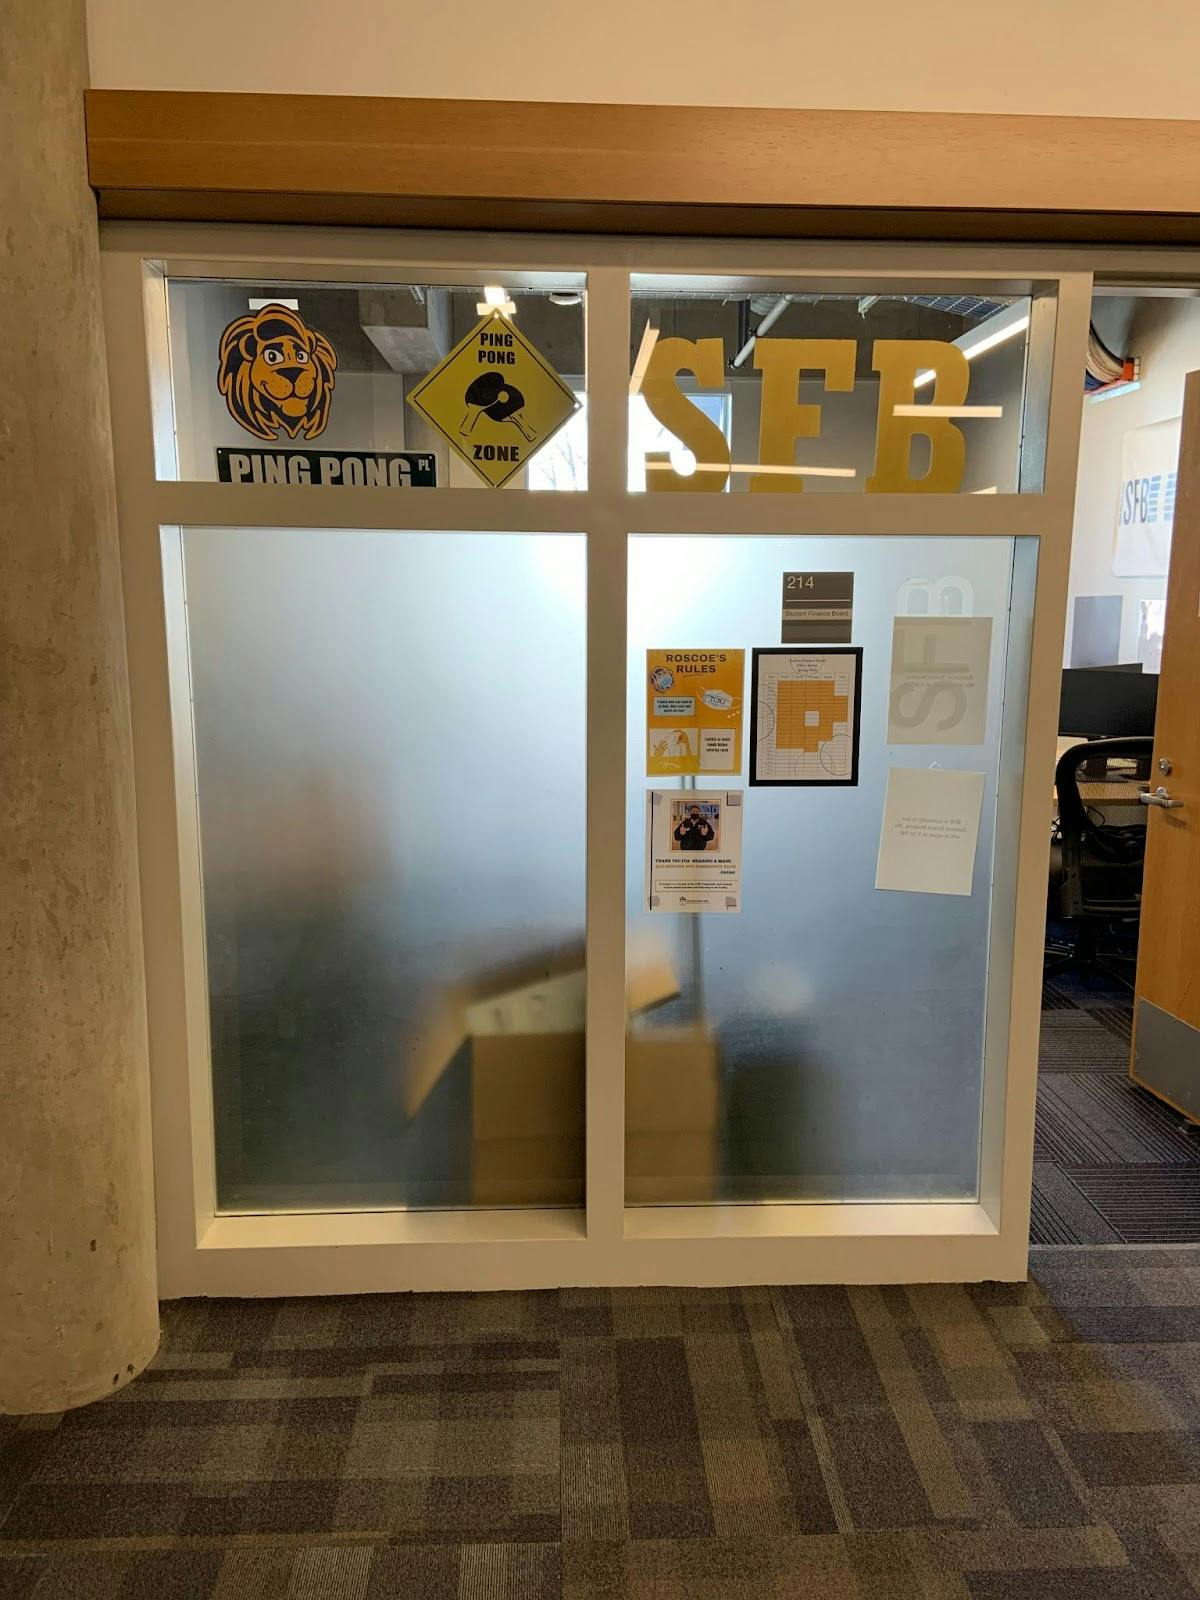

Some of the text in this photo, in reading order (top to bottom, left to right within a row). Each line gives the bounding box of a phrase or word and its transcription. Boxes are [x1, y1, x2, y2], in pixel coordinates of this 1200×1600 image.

[480, 332, 514, 347] PING
[477, 350, 516, 365] PONG
[644, 337, 970, 494] SFB
[473, 444, 520, 462] ZONE
[229, 453, 431, 486] PING PONG PL
[1123, 478, 1150, 525] SFB
[786, 576, 815, 589] 214
[666, 653, 727, 663] ROSCOE'S
[676, 664, 717, 674] RULES
